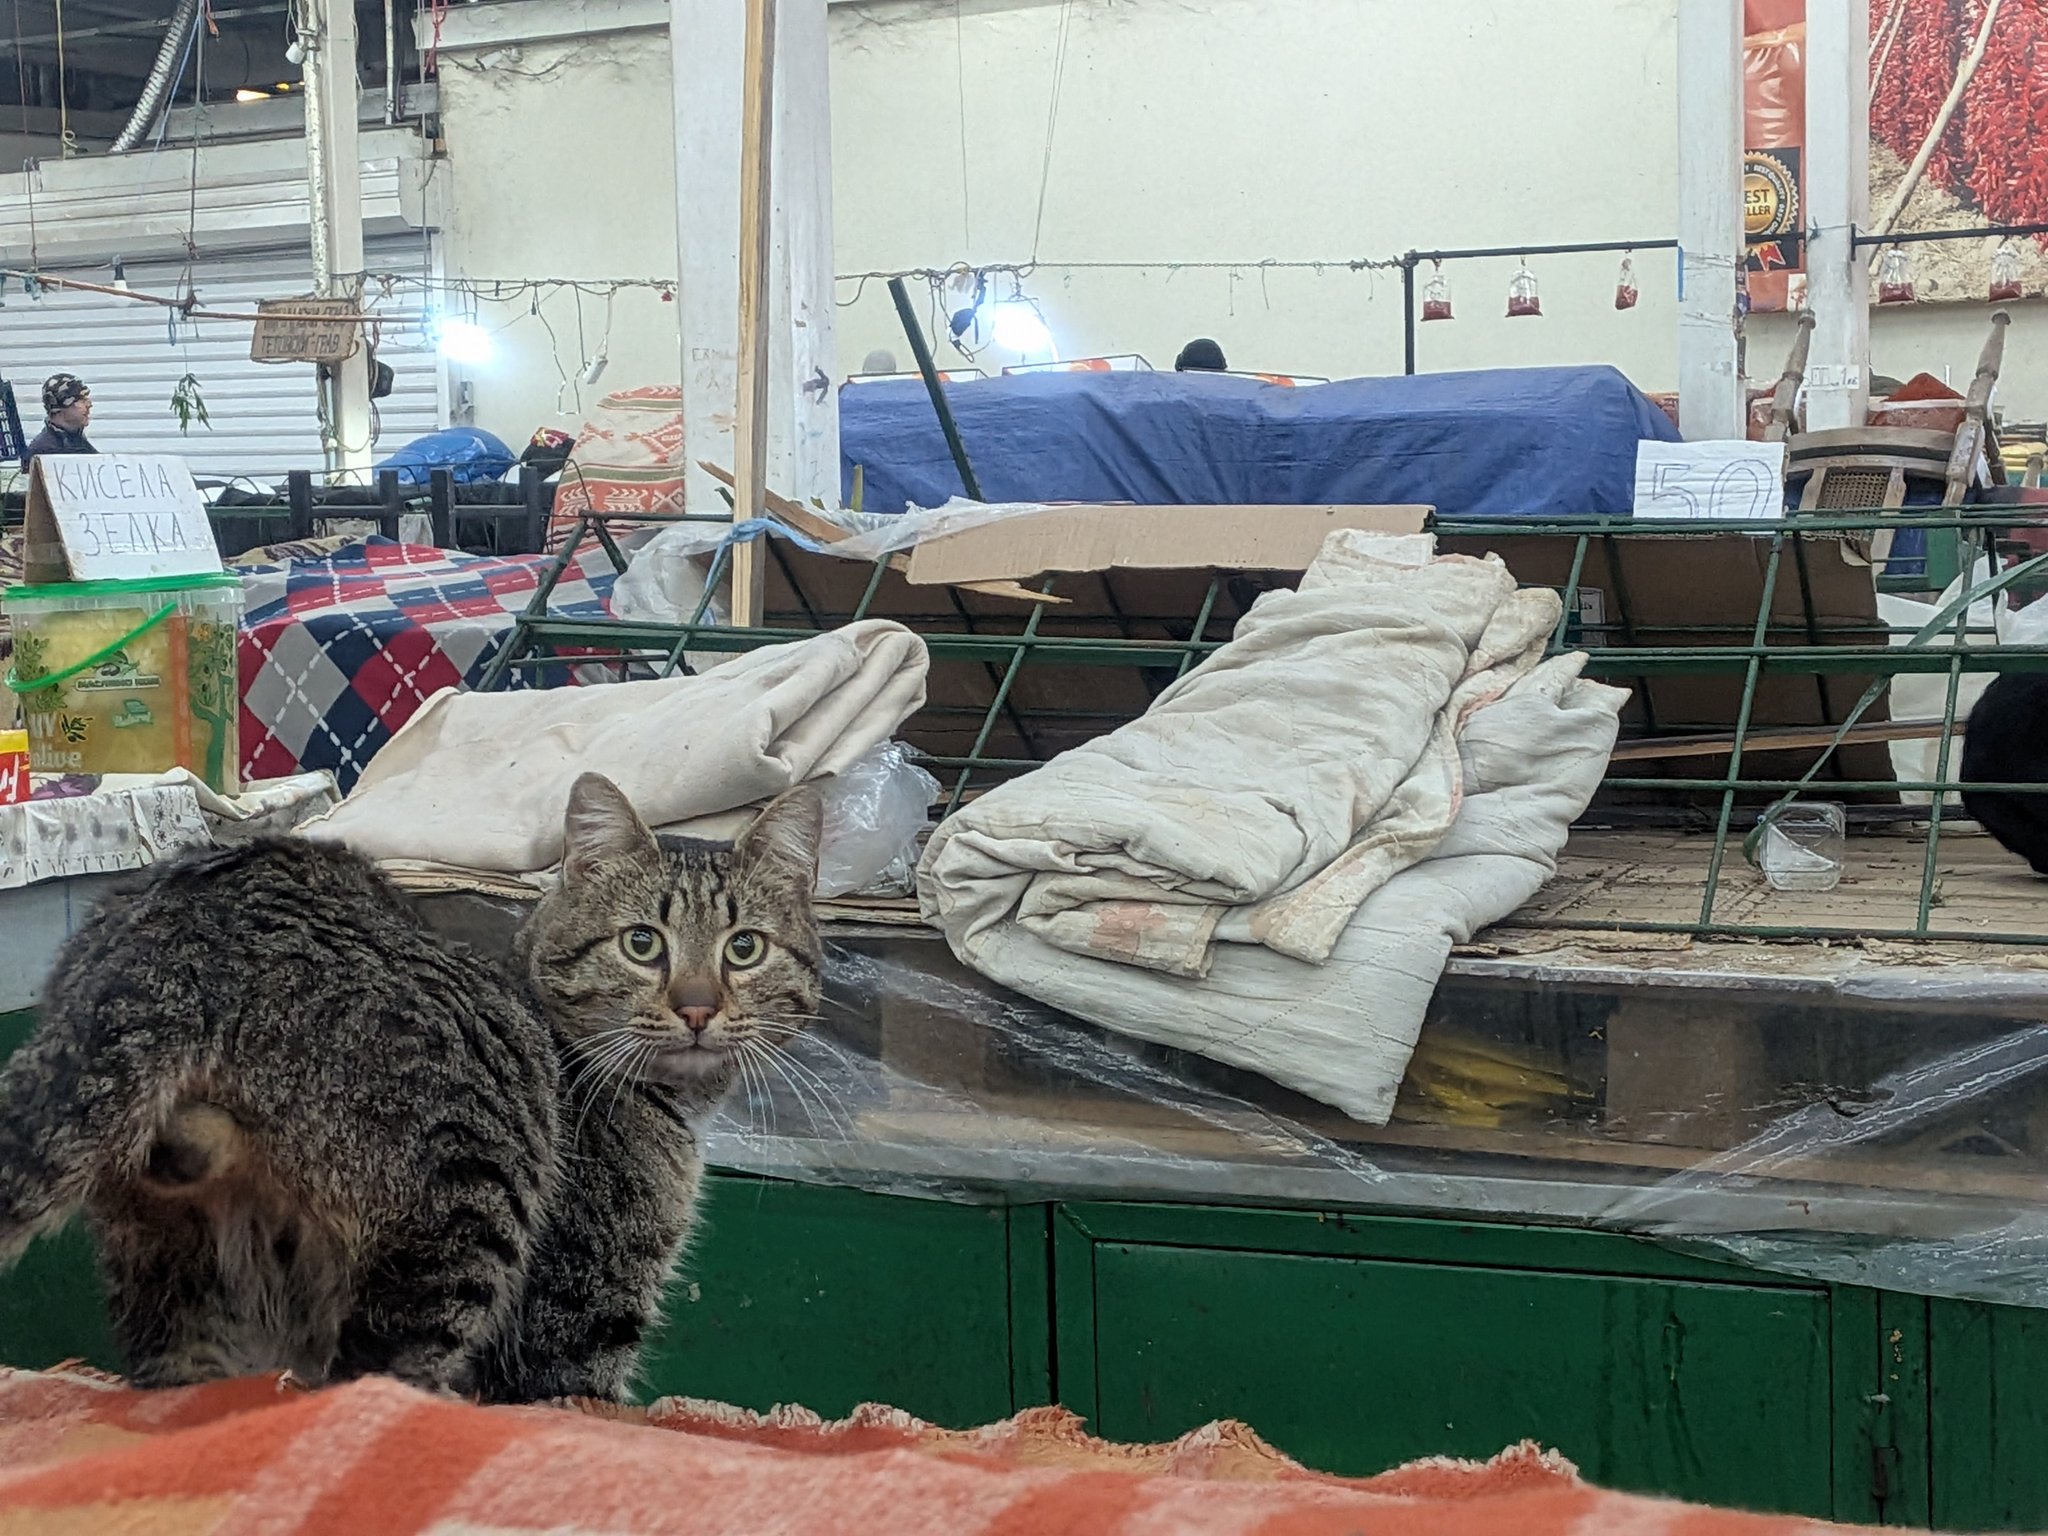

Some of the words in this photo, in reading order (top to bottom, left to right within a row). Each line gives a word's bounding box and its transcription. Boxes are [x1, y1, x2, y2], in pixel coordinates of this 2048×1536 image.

[1745, 189, 1770, 204] EST
[1745, 205, 1771, 216] LLER
[53, 462, 176, 502] КИСЕЛА
[1653, 460, 1773, 518] 50
[78, 511, 188, 557] ЗЕЛКА
